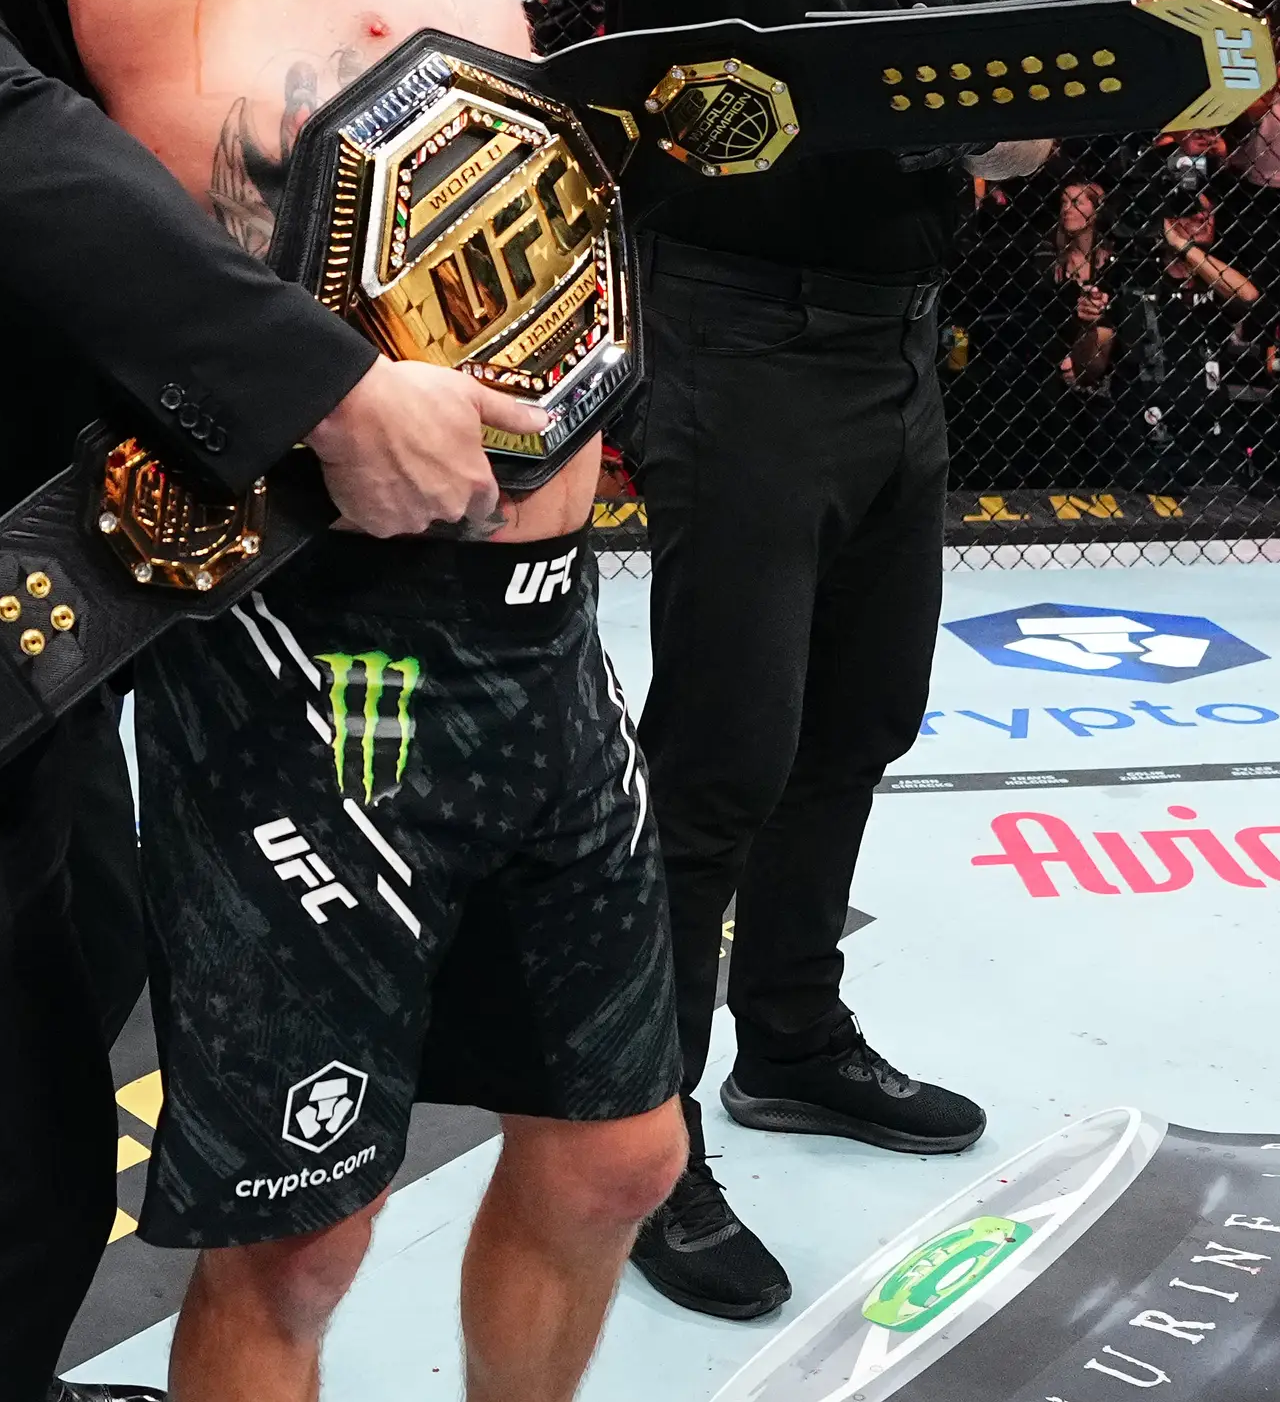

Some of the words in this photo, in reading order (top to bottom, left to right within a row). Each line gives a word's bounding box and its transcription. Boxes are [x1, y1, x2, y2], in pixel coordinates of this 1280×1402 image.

[1214, 27, 1261, 89] UFC
[428, 156, 596, 347] UFC
[504, 274, 598, 367] CHAMPION
[505, 545, 578, 605] UFC
[253, 816, 359, 925] UFC
[234, 1141, 377, 1200] crypto.com
